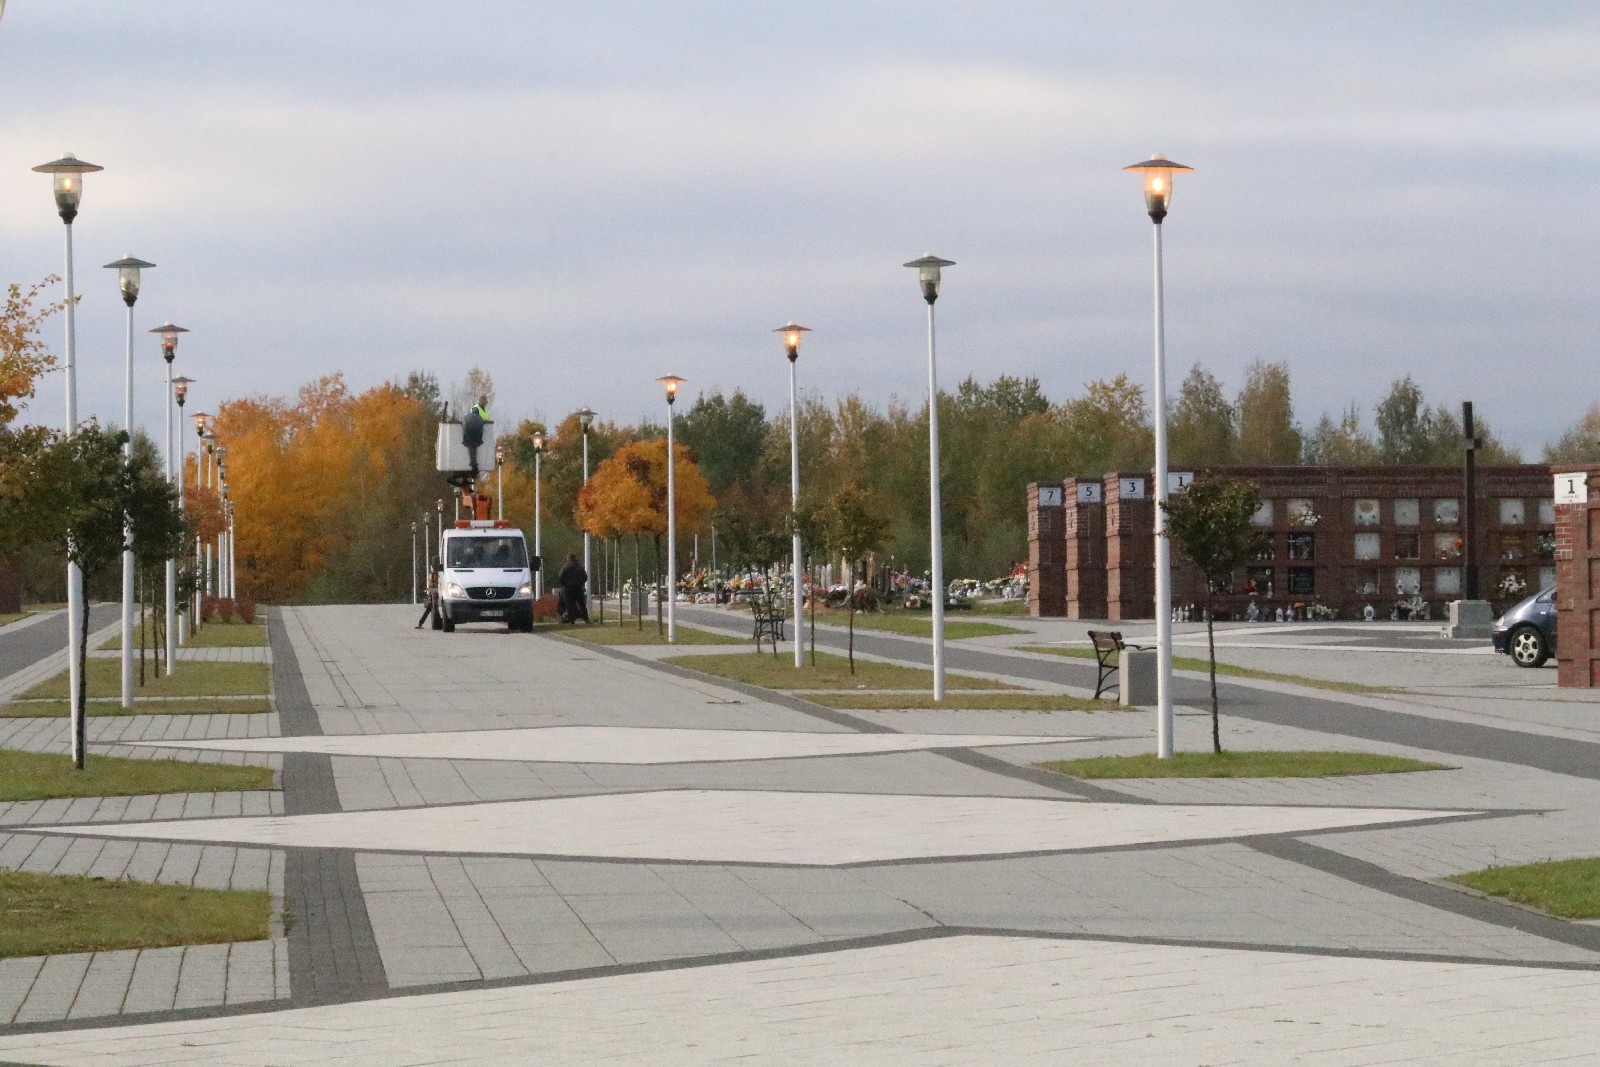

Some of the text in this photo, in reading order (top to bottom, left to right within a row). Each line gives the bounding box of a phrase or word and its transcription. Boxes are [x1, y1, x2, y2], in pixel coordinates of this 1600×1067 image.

[1178, 476, 1184, 487] 1
[1567, 479, 1575, 494] 1
[1085, 486, 1093, 497] 5
[1128, 482, 1136, 493] 3
[1047, 490, 1054, 500] 7
